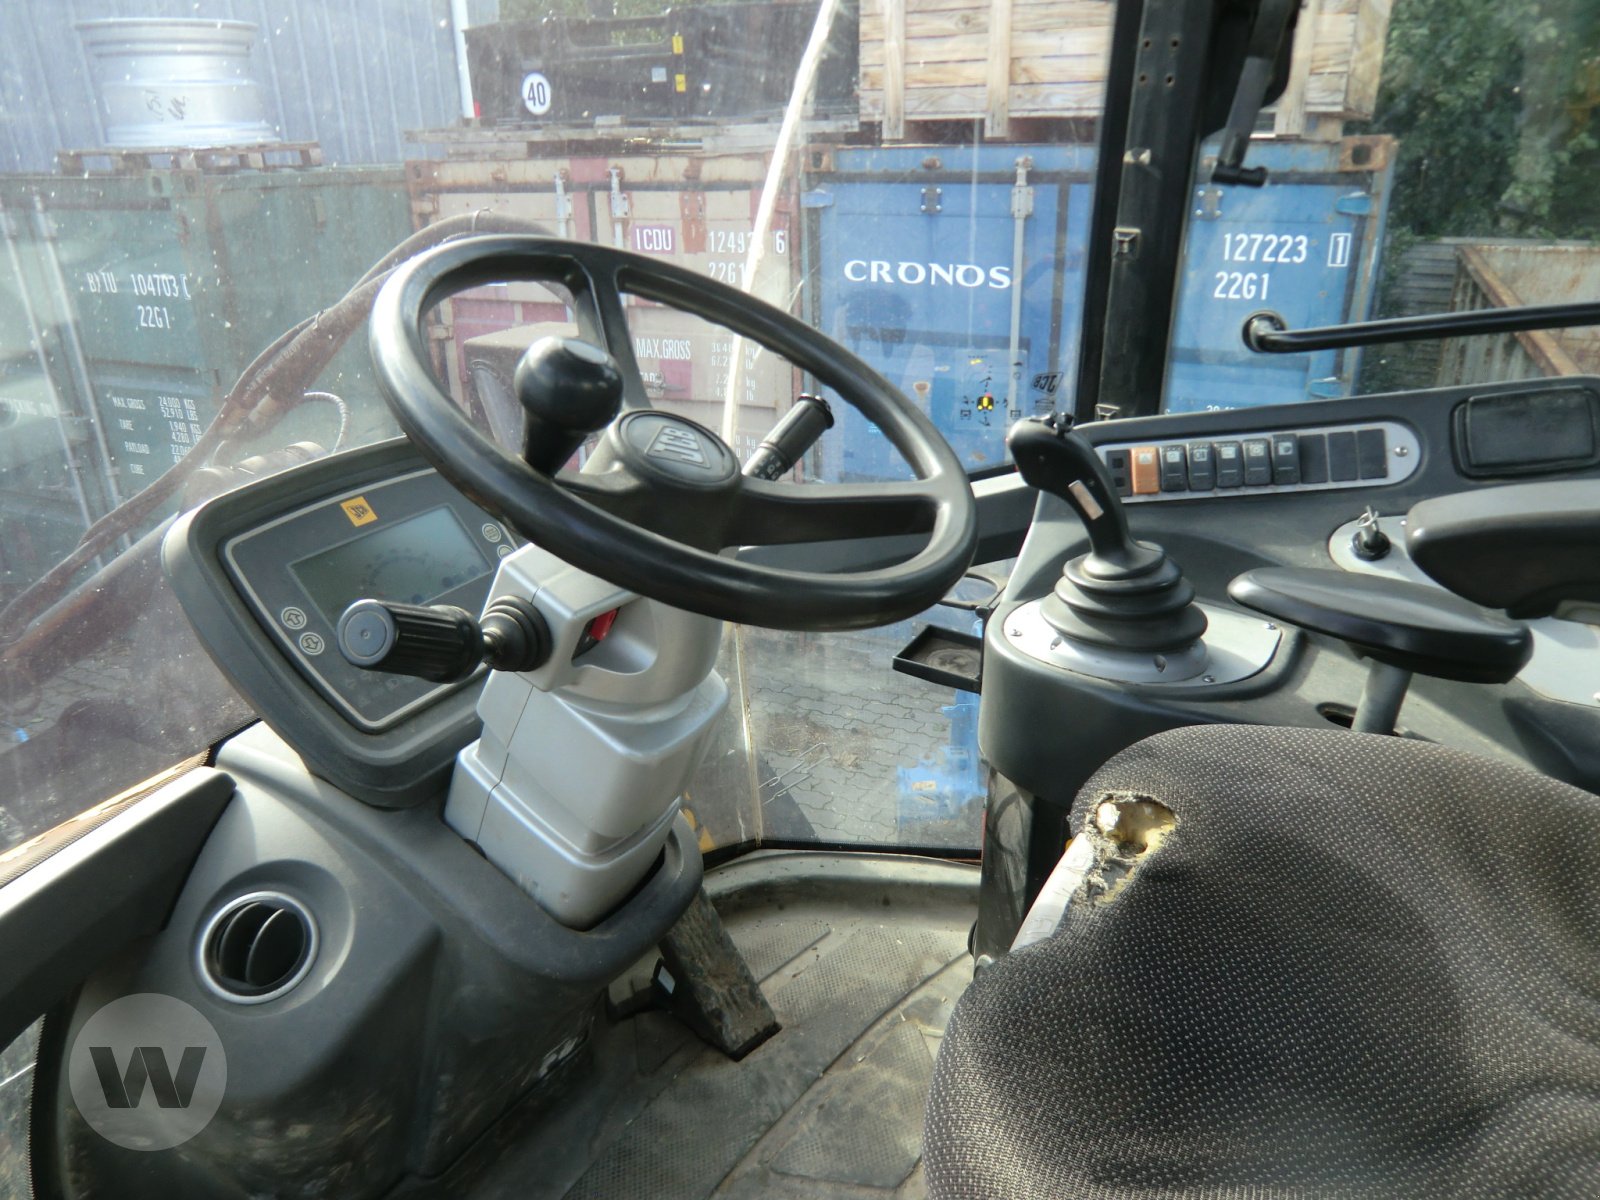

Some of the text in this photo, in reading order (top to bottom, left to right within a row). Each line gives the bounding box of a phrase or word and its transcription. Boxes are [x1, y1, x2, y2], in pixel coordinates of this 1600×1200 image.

[527, 82, 545, 106] 40
[636, 228, 672, 251] ICDU
[775, 230, 785, 253] 6
[1224, 233, 1308, 263] 127223
[130, 273, 179, 297] 104703
[844, 260, 1011, 289] CRONOS
[1214, 271, 1270, 300] 22G1
[137, 305, 170, 329] 22G1
[635, 338, 691, 360] MAX.GROSS
[653, 427, 704, 464] JCB
